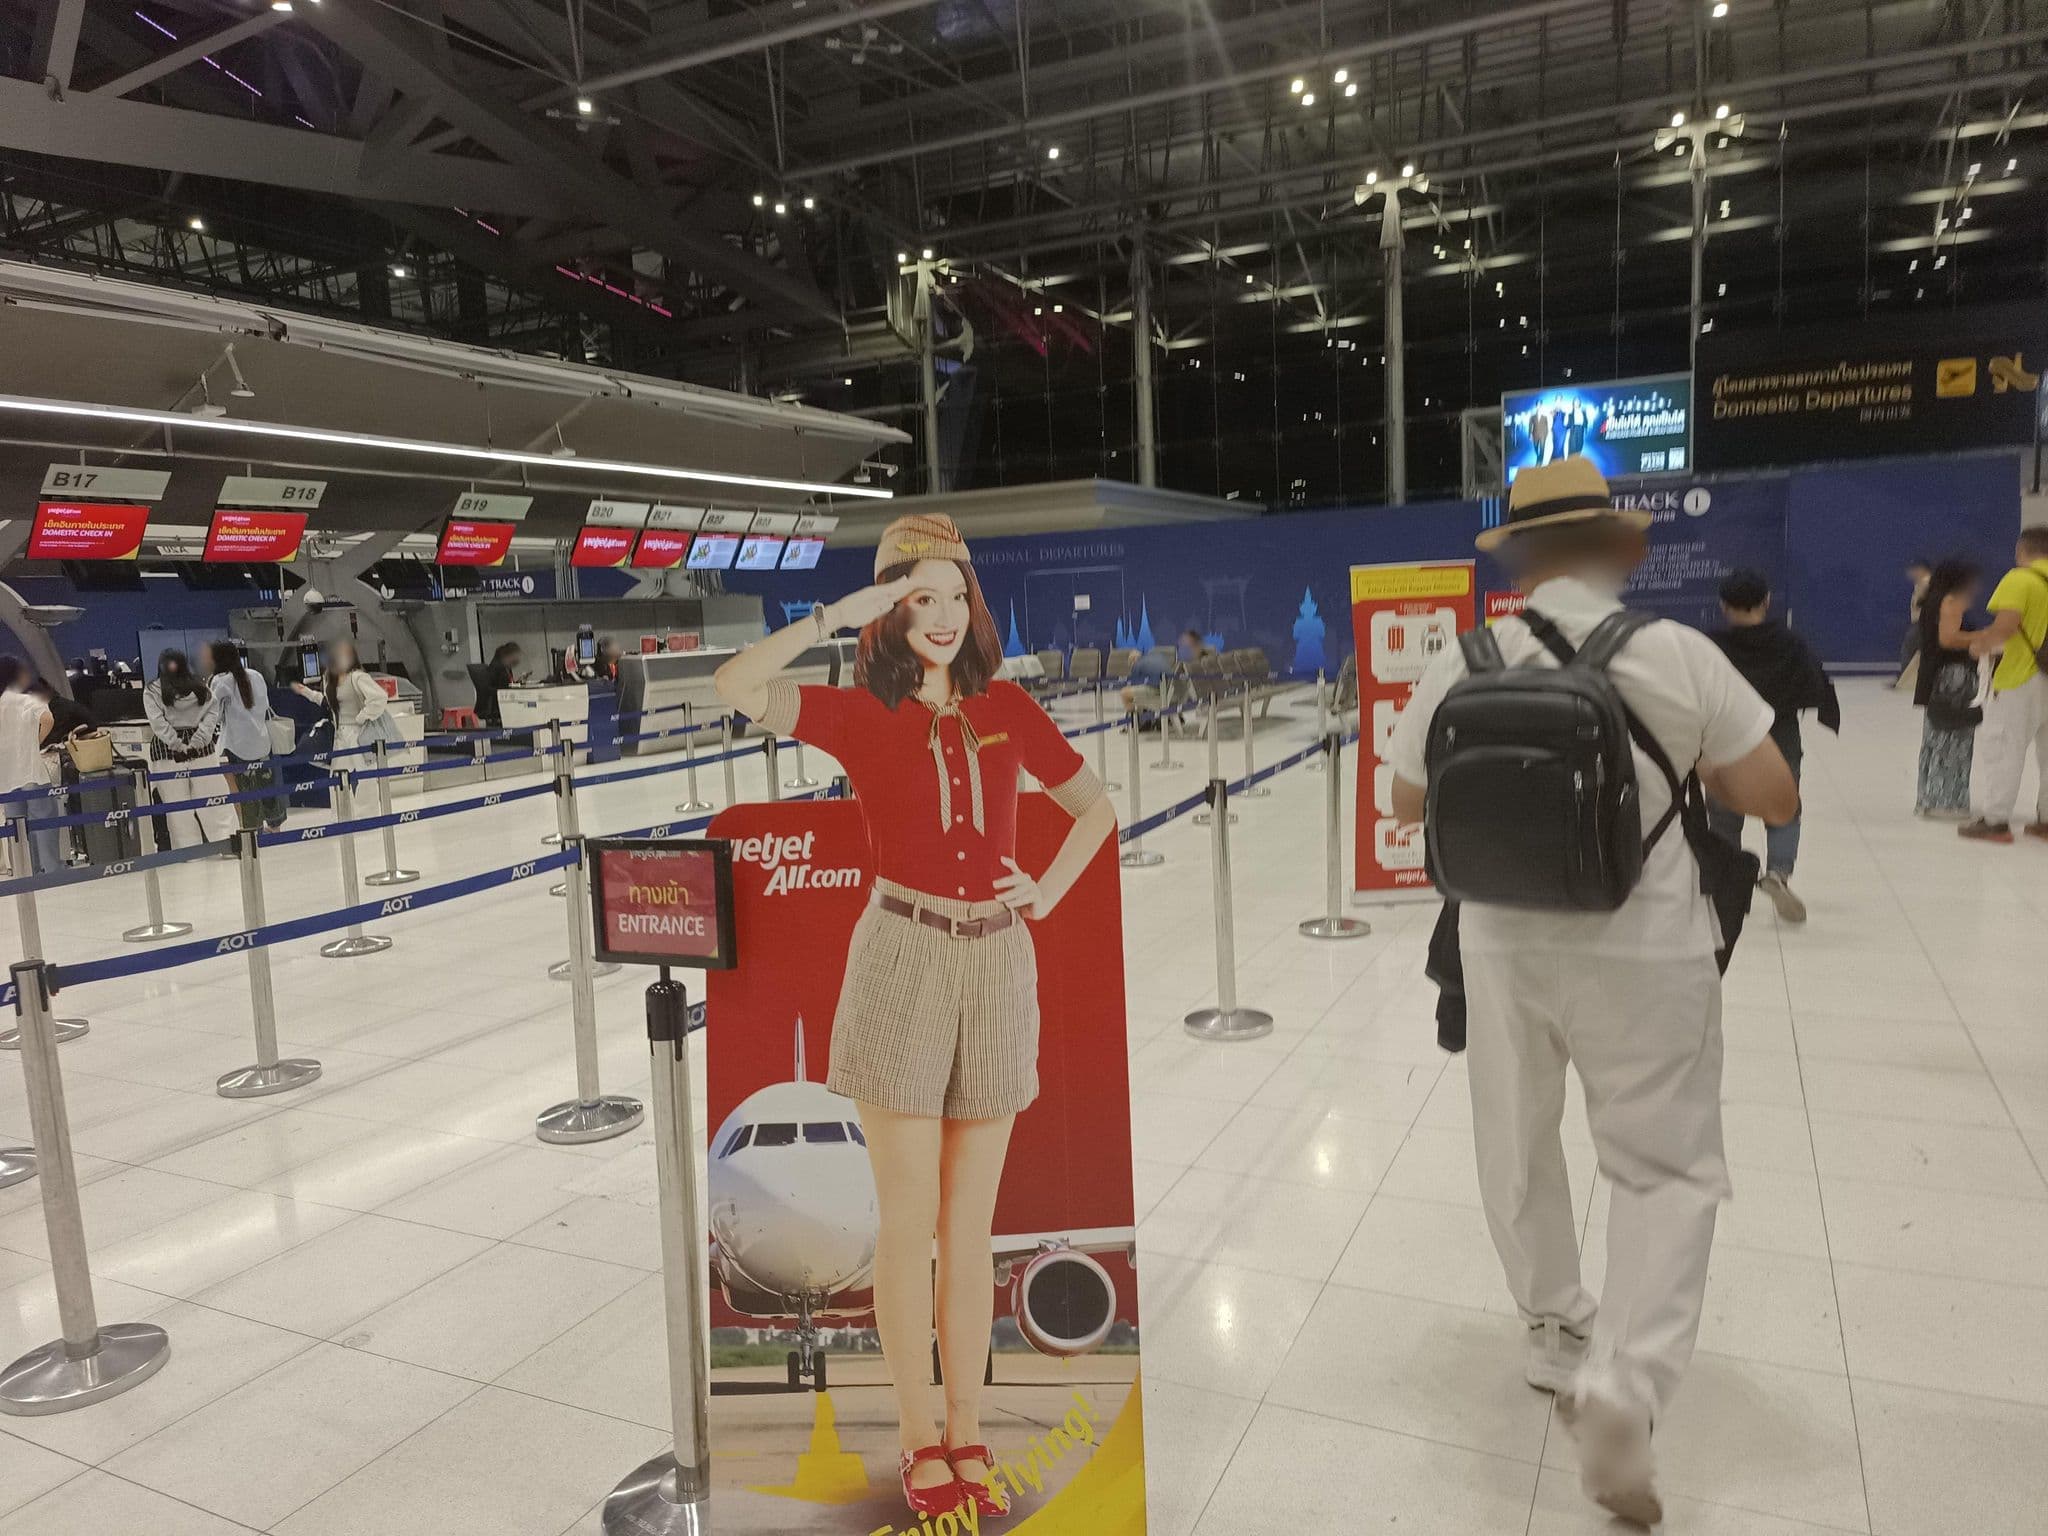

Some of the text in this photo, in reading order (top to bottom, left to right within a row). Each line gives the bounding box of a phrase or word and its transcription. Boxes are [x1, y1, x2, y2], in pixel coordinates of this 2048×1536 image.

[1713, 384, 1912, 420] Domestic Departures
[52, 472, 98, 489] B17
[282, 486, 317, 500] B18
[461, 498, 488, 511] B19
[1610, 490, 1680, 512] TRACK
[591, 505, 614, 518] B20
[653, 510, 672, 521] B21
[42, 528, 79, 537] DOMESTIC
[488, 577, 520, 590] TRACK
[313, 752, 328, 761] AOT
[471, 756, 486, 765] AOT
[247, 762, 264, 770] AOT
[402, 766, 419, 774] AOT
[175, 771, 191, 779] AOT
[47, 786, 69, 796] AOT
[295, 782, 314, 792] AOT
[206, 796, 228, 806] AOT
[483, 795, 502, 806] AOT
[106, 809, 131, 821] AOT
[399, 811, 420, 823] AOT
[301, 827, 326, 840] AOT
[650, 825, 671, 838] AOT
[730, 831, 815, 870] ietjet
[103, 860, 135, 877] AOT
[511, 861, 536, 881] AOT
[628, 879, 689, 905] ทางเข้า
[380, 895, 412, 915] AOT
[618, 913, 705, 937] ENTRANCE
[216, 931, 258, 954] AOT
[980, 1391, 1100, 1512] Flying!
